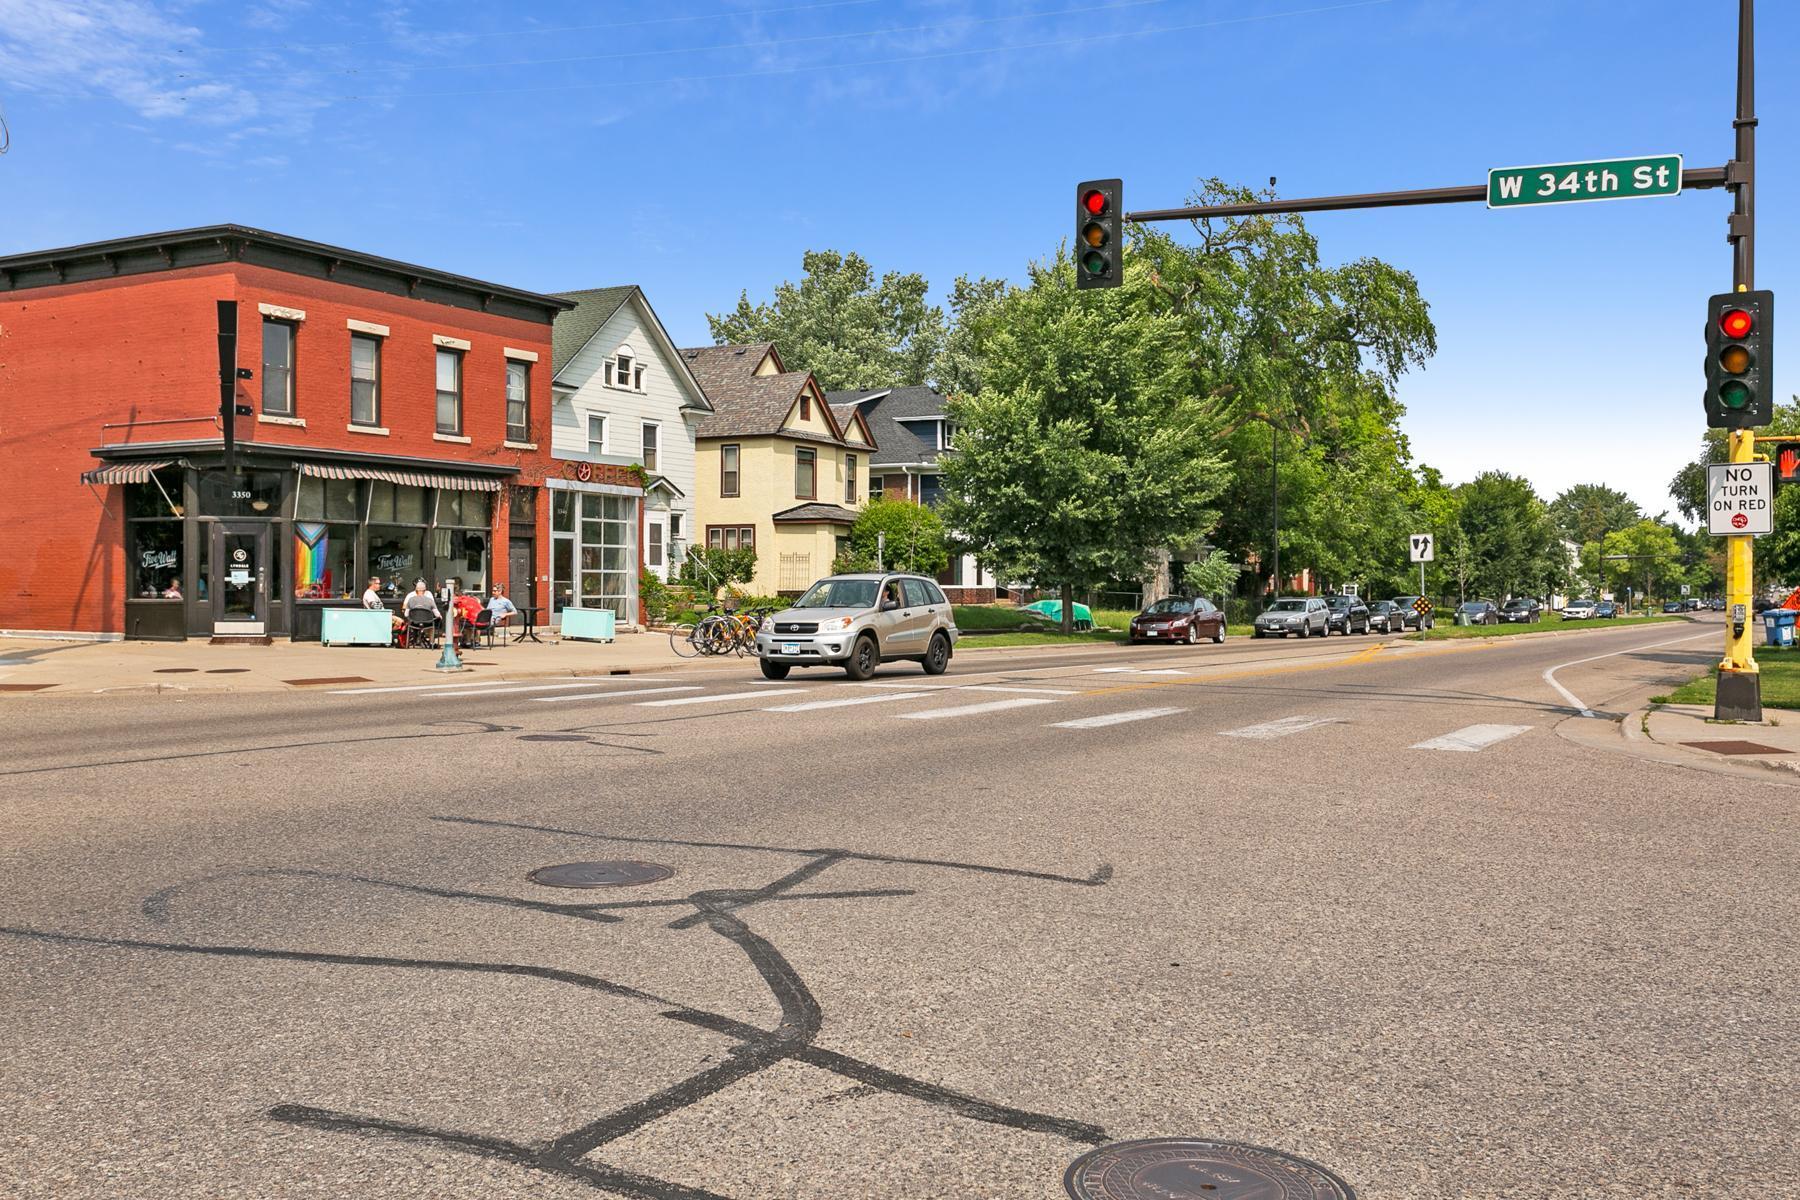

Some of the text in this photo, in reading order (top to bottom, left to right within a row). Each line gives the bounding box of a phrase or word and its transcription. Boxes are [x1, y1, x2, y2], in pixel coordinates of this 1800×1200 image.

[1498, 164, 1670, 199] W 34th St
[1726, 468, 1752, 482] NO
[231, 491, 251, 499] 3350
[1721, 485, 1758, 497] TURN
[1713, 499, 1766, 511] ON RED
